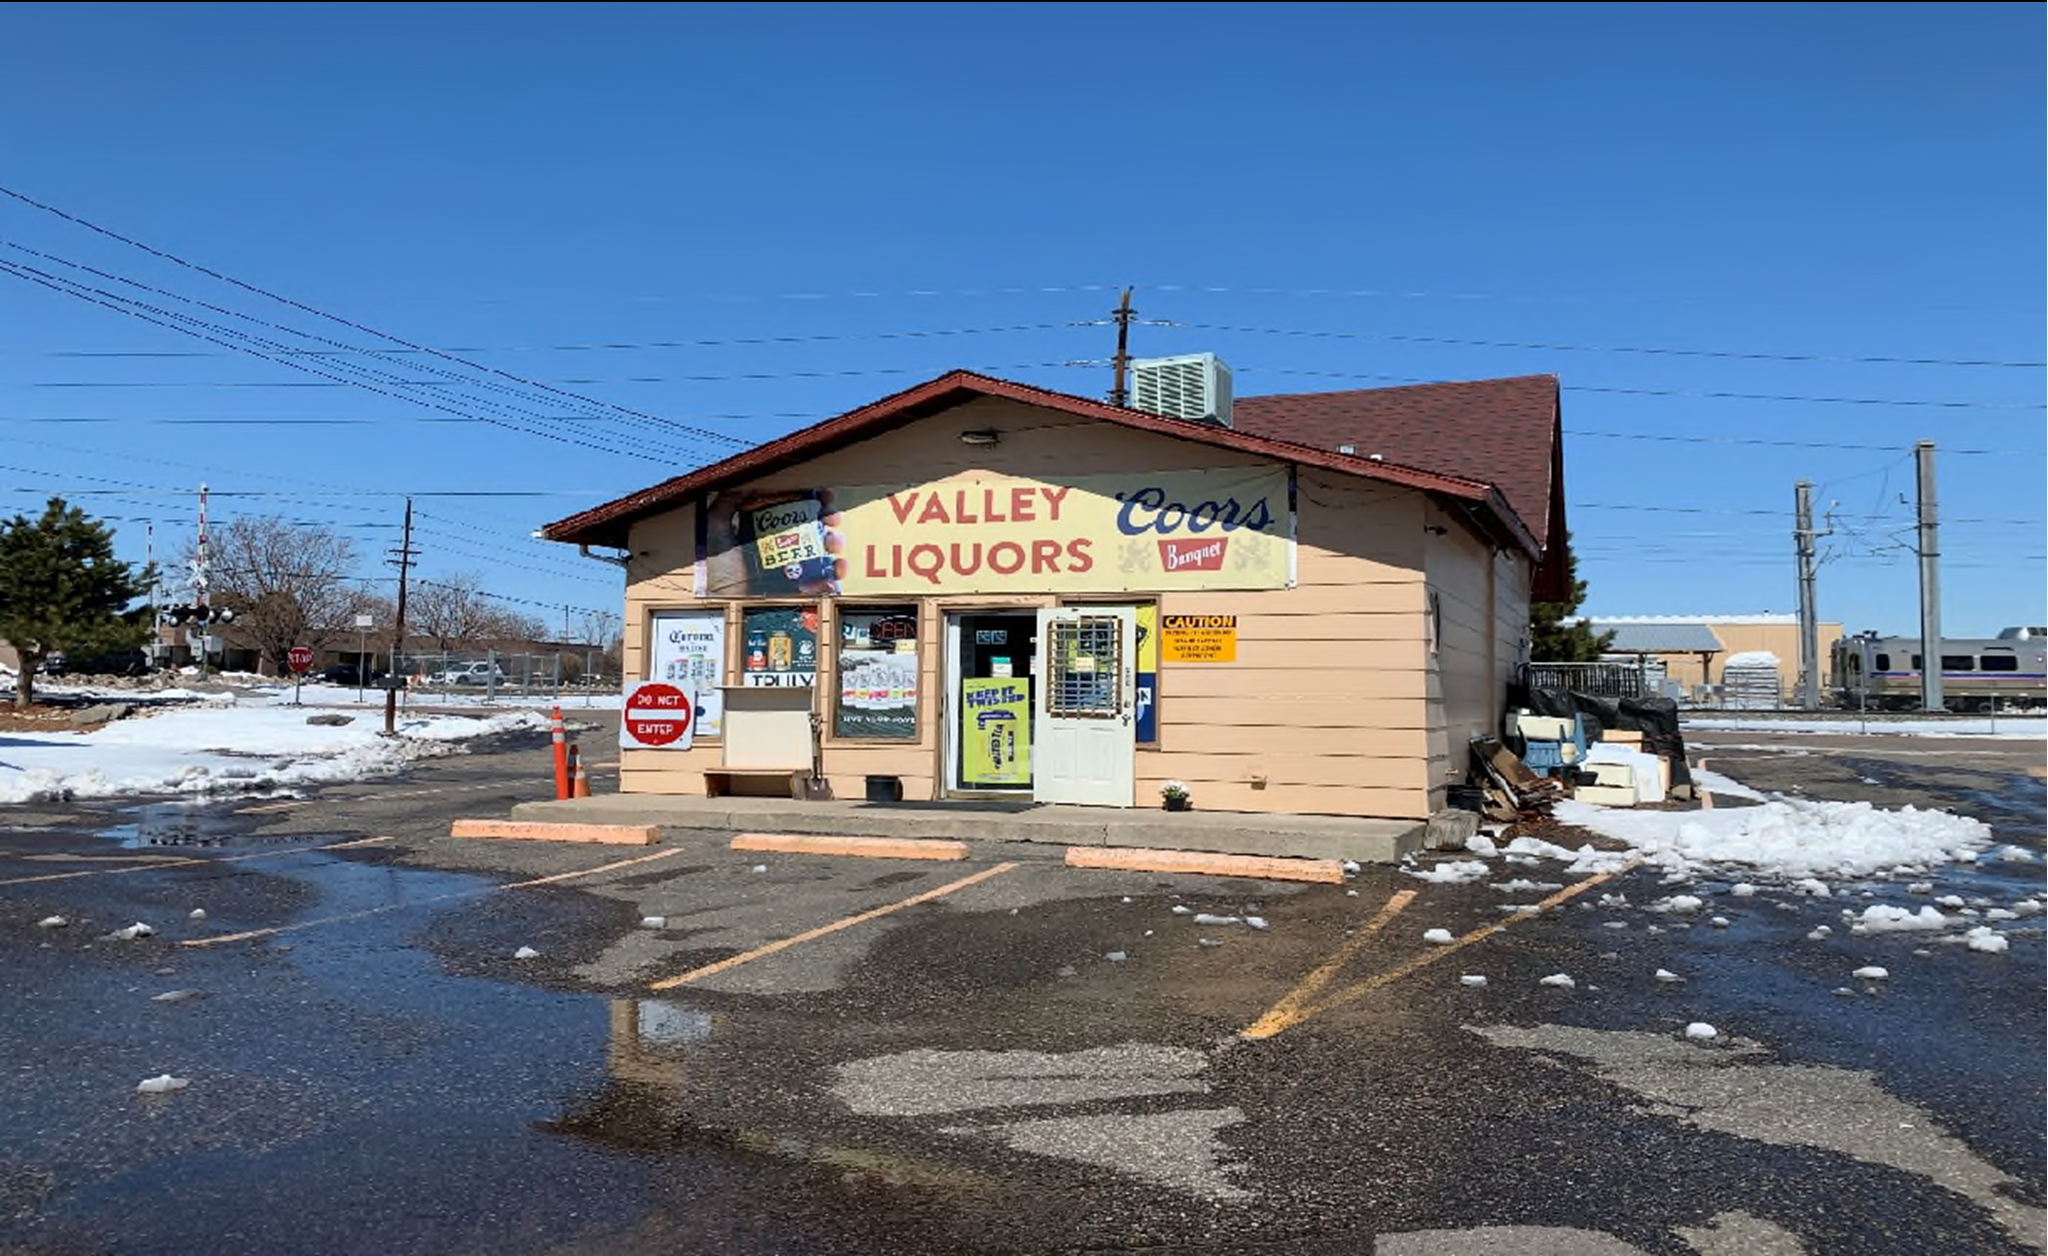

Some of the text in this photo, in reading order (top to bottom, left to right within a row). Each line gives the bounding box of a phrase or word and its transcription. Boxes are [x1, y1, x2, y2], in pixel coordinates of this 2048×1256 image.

[887, 488, 1071, 525] VALLEY
[1115, 487, 1274, 535] Coors
[755, 510, 808, 532] Coors
[764, 544, 816, 566] BEER
[866, 538, 1094, 584] LIQUORS
[1167, 541, 1222, 570] Banquet
[1165, 616, 1233, 628] CAUTION
[288, 653, 313, 663] STOP
[637, 694, 681, 706] DO NOT
[637, 724, 674, 735] ENTER
